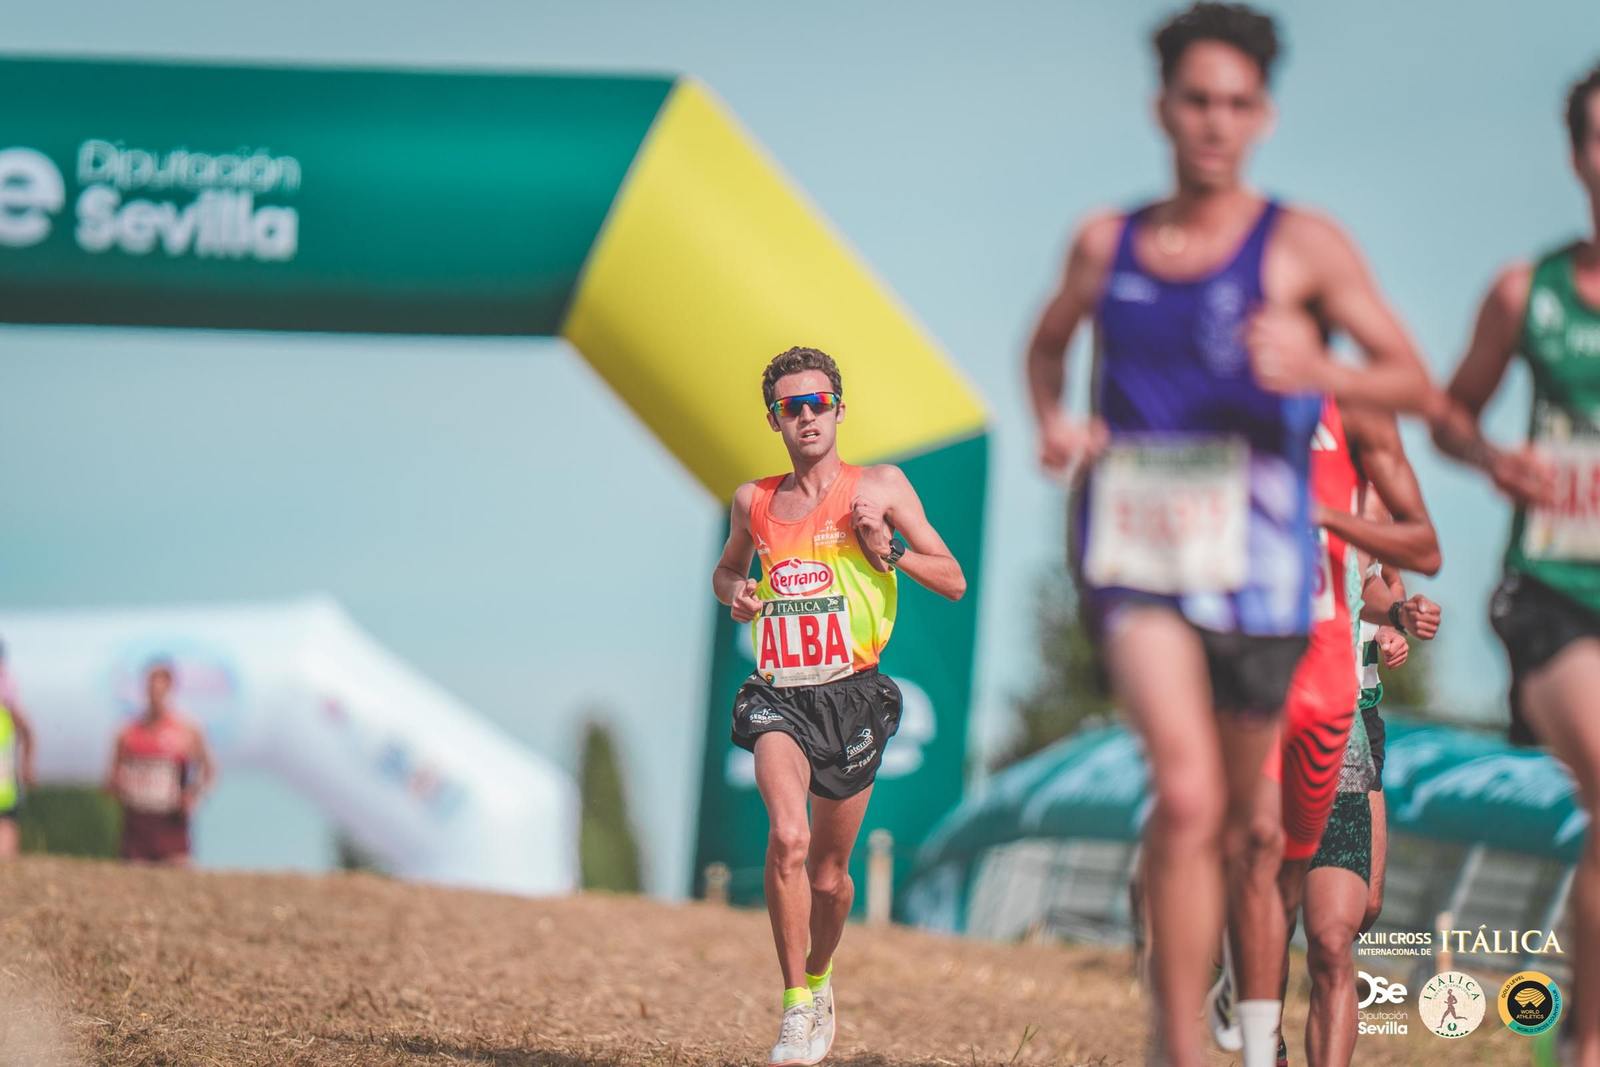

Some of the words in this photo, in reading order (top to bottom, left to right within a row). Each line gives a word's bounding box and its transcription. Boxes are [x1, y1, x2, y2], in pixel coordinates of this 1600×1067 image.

[75, 184, 299, 261] Sevilla
[813, 531, 846, 542] SERRANO
[771, 567, 829, 588] Serrano
[777, 601, 821, 613] ITÁLICA
[760, 613, 849, 669] ALBA
